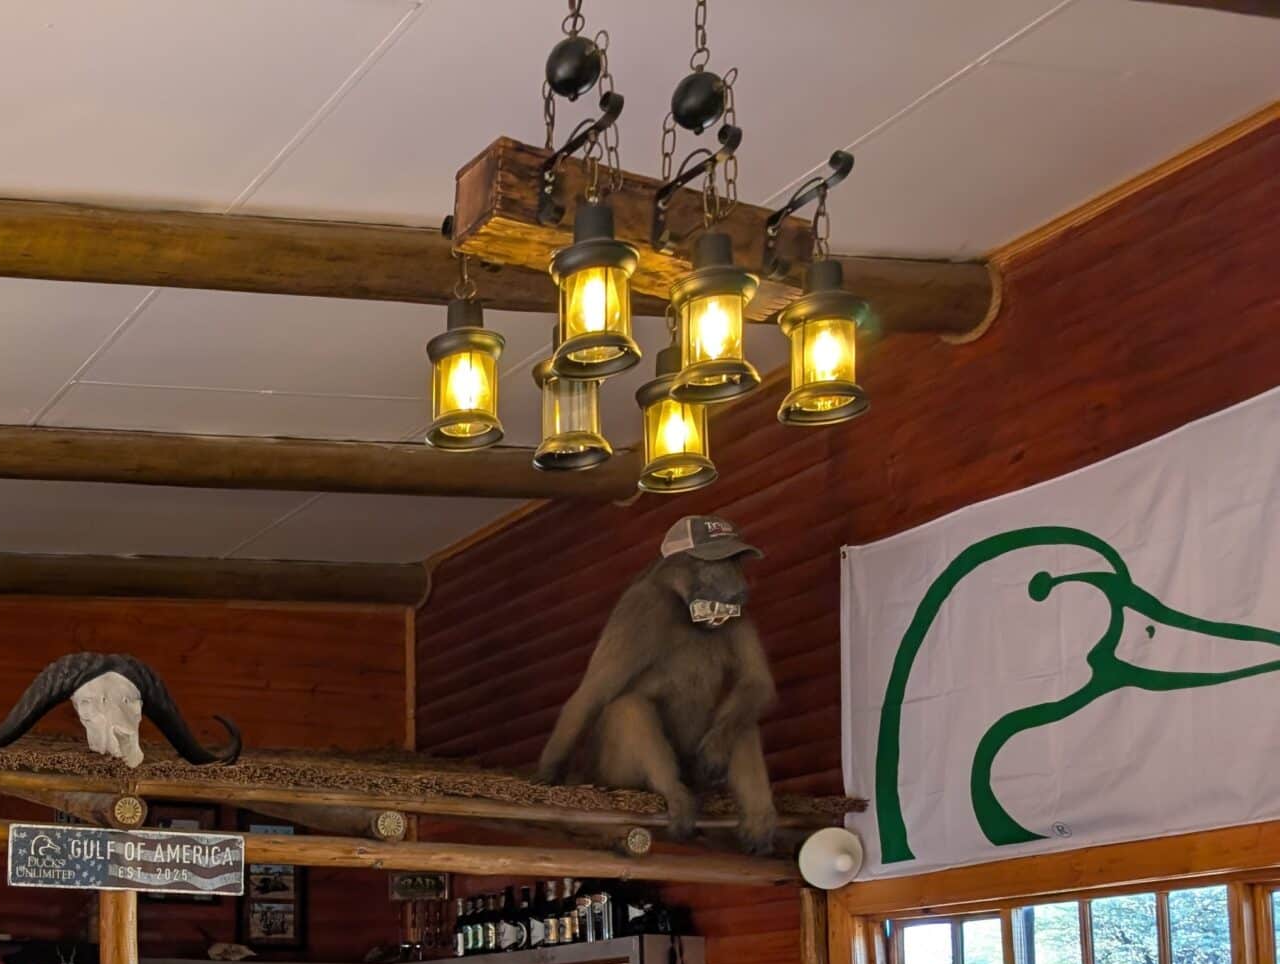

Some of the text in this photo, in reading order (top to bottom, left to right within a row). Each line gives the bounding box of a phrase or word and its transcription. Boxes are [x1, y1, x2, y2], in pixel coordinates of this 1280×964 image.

[70, 839, 234, 867] GULF OF AMERICA
[27, 855, 66, 868] DUCKS
[15, 865, 76, 880] UNLIMITED
[155, 868, 188, 881] 2025
